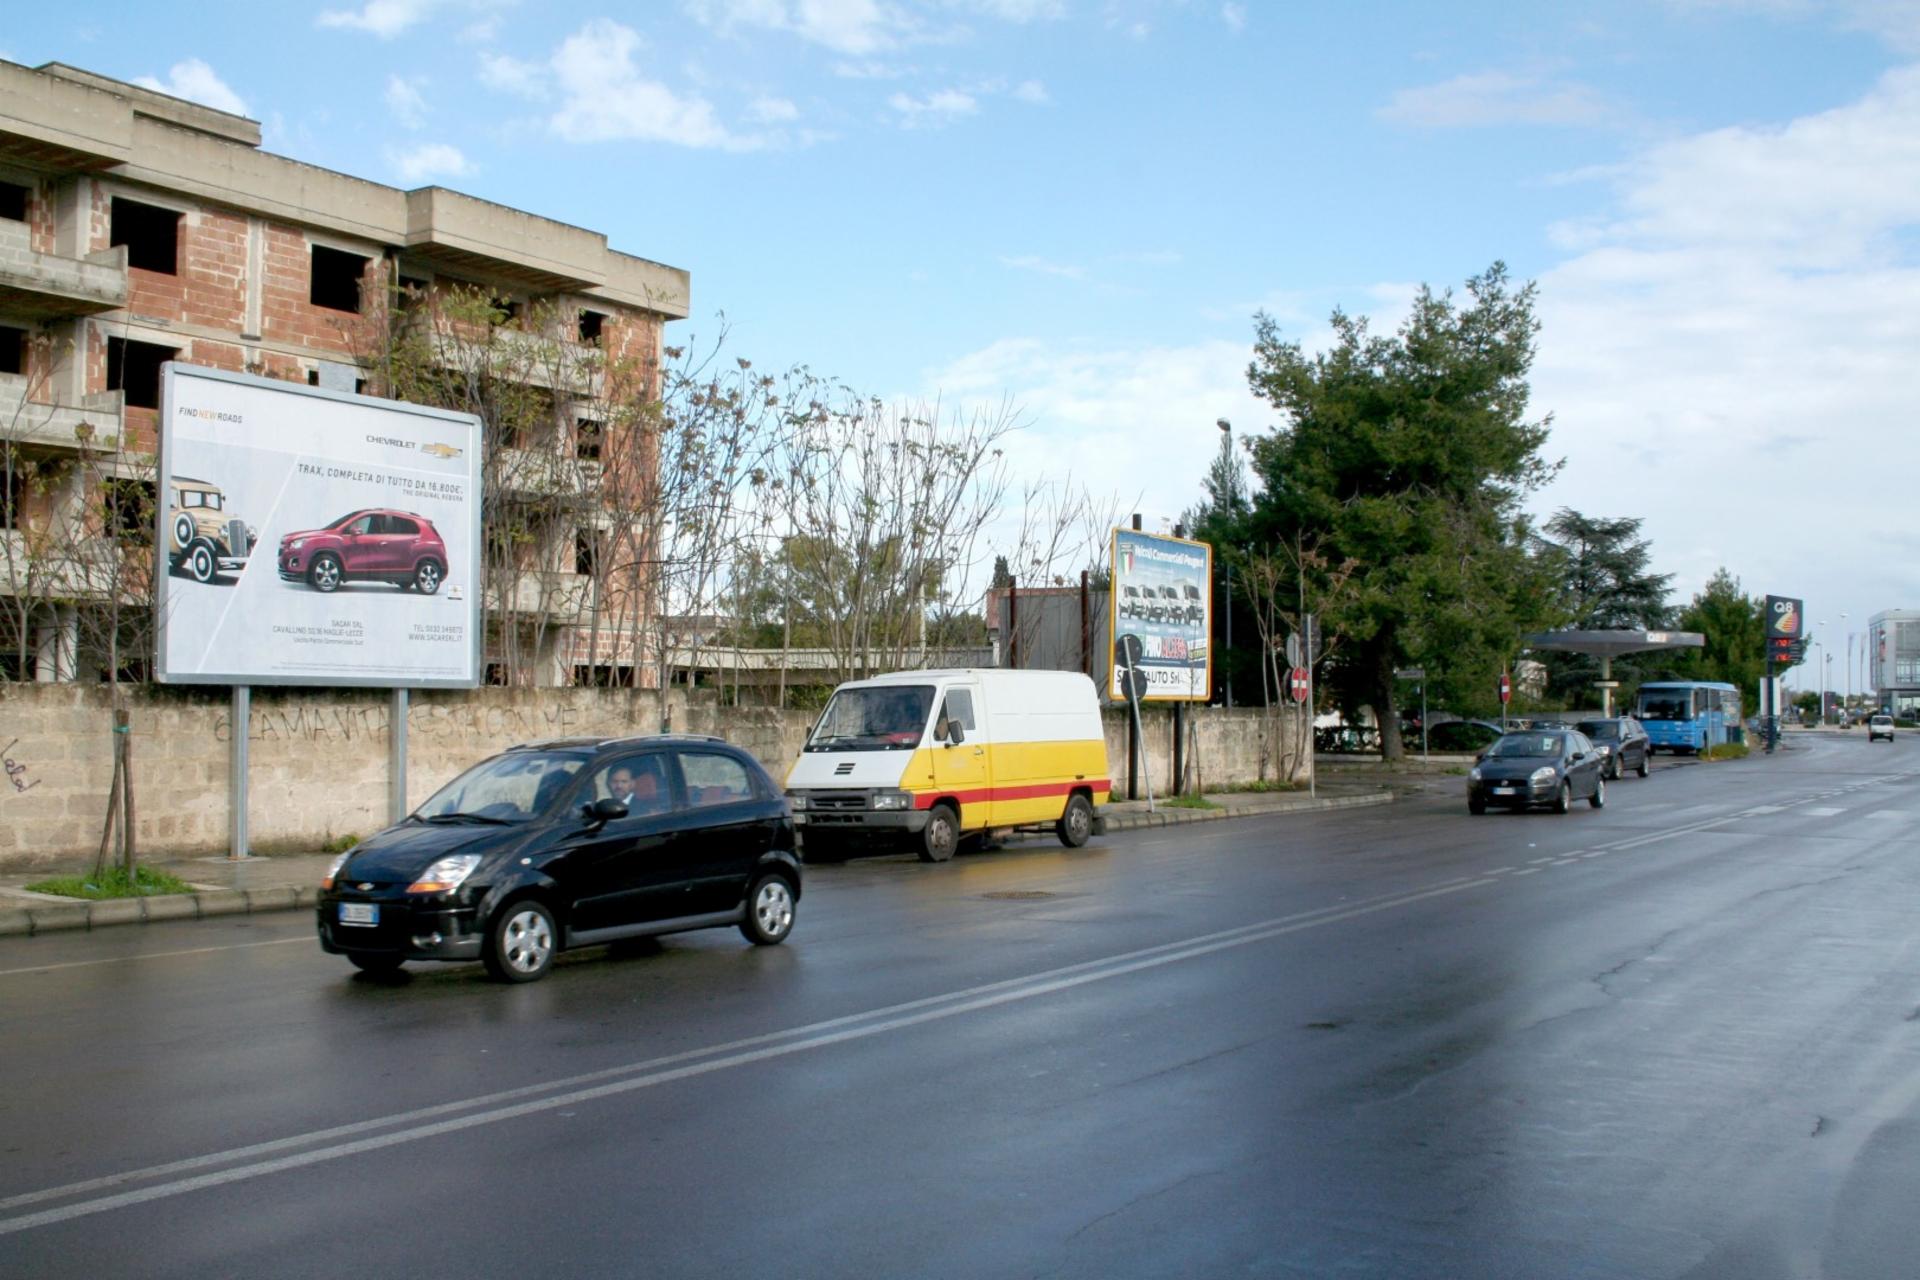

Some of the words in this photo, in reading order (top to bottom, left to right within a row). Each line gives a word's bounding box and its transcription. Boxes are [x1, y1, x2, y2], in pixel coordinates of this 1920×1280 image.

[366, 435, 416, 448] CHEVROLET
[327, 468, 373, 482] COMPLETA
[376, 474, 385, 484] DI
[387, 476, 413, 488] TUTTO
[415, 480, 426, 489] DA
[1774, 602, 1793, 613] Q8
